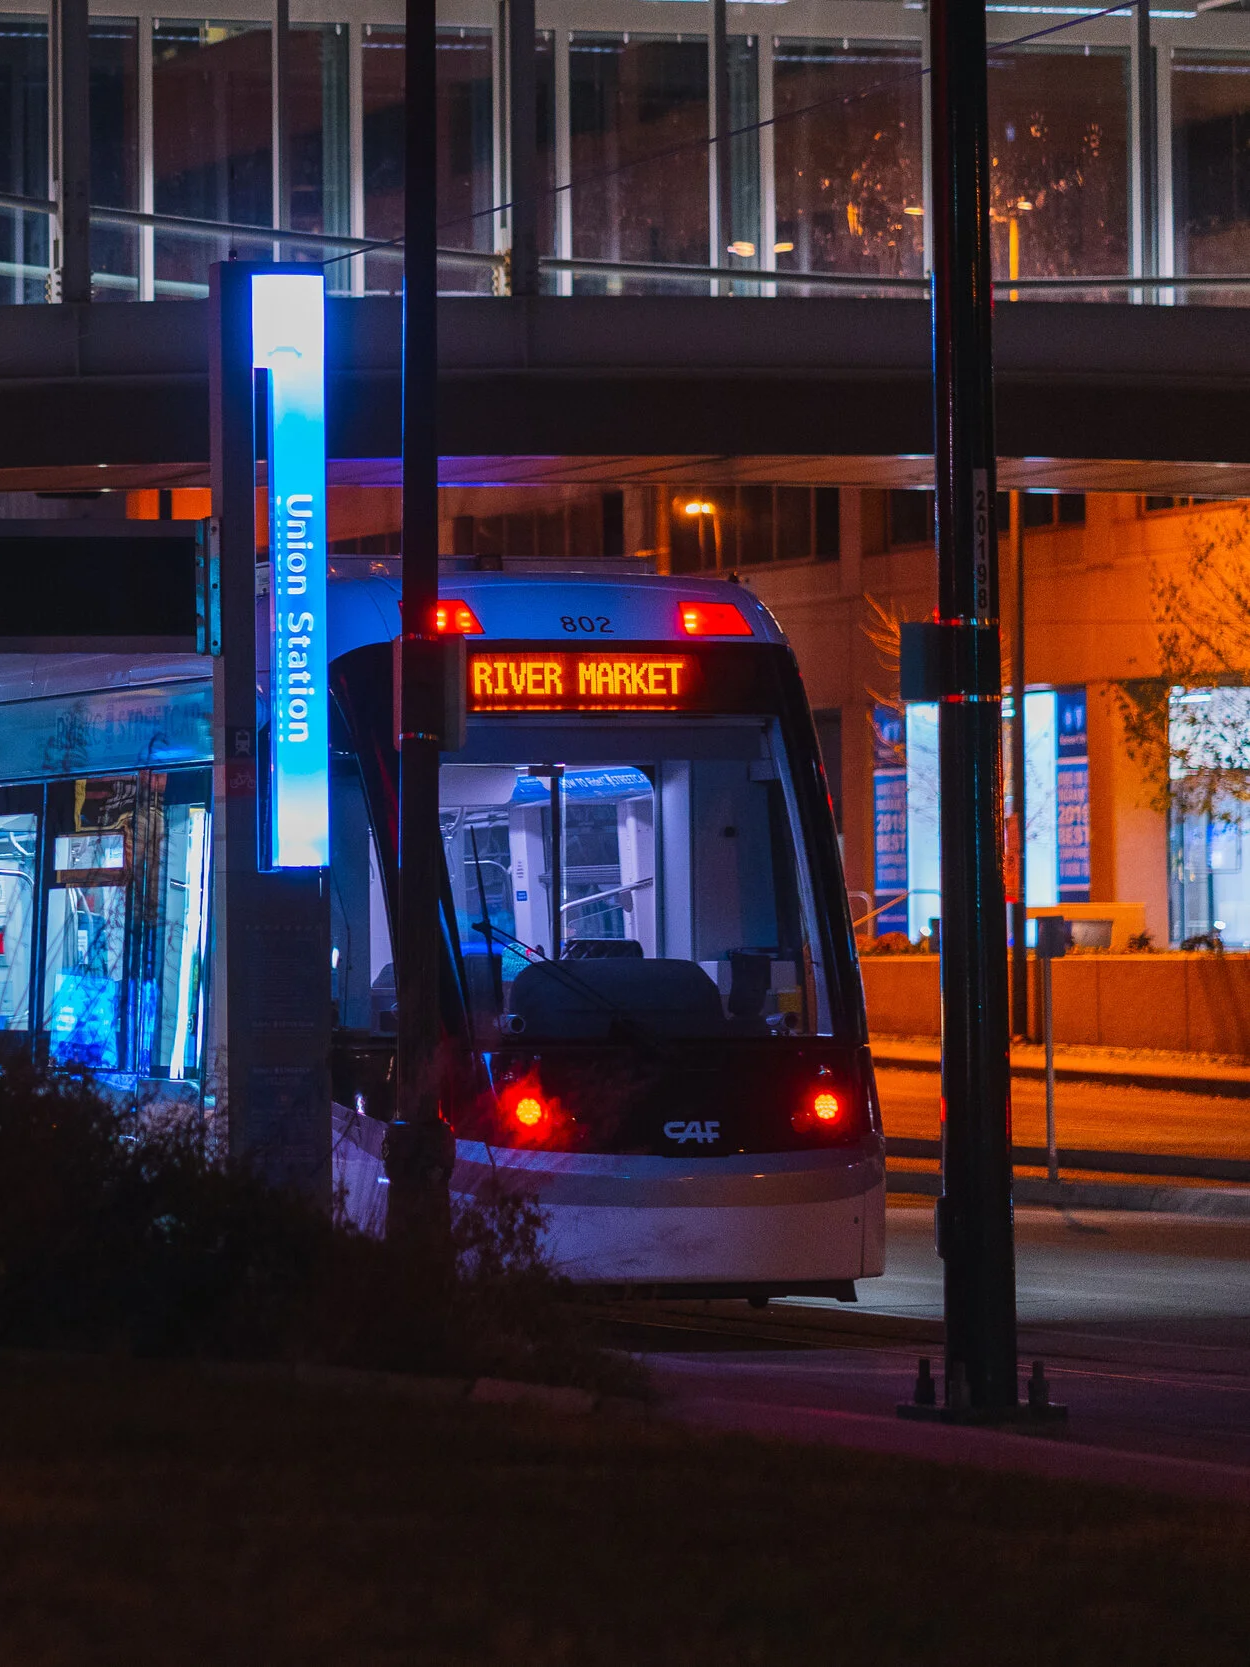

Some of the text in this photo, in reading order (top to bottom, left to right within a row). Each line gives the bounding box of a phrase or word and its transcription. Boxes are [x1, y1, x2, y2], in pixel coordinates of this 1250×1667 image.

[976, 489, 988, 610] 20198
[286, 493, 315, 743] Union Station
[560, 616, 615, 633] 802
[473, 662, 684, 695] RIVER MARKET
[663, 1121, 720, 1144] CAF
